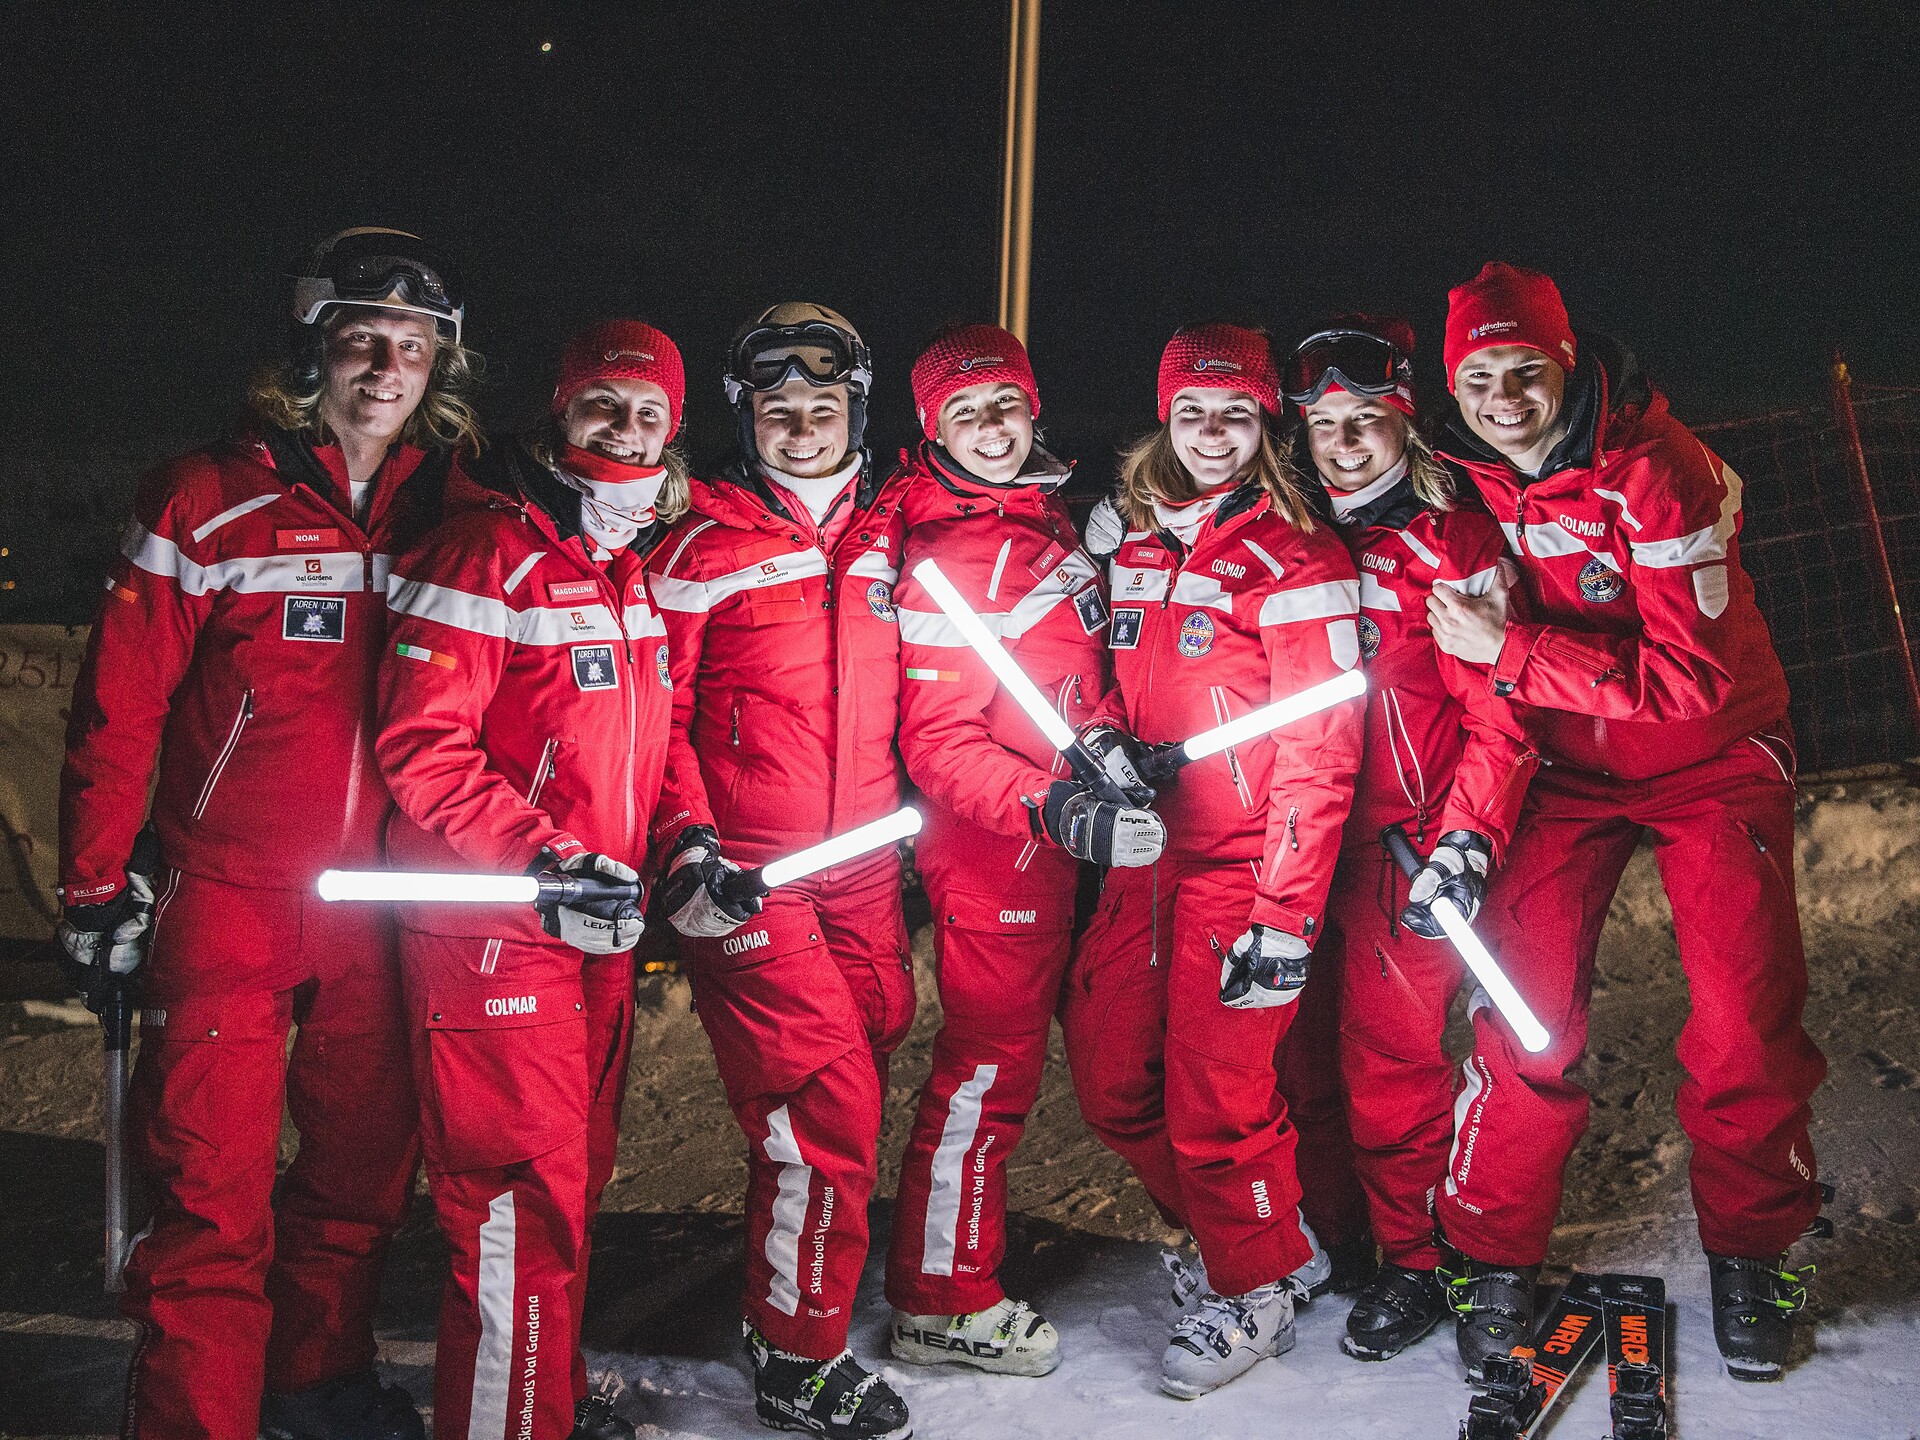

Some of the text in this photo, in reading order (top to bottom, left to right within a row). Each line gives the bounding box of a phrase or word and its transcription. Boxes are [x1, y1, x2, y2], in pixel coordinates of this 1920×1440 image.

[1479, 320, 1518, 332] skischools
[619, 350, 655, 361] skischools
[1208, 359, 1242, 371] skischools
[1559, 514, 1606, 537] COLMAR
[295, 534, 320, 542] NOAH
[1039, 553, 1055, 569] LAURA
[1137, 551, 1155, 559] GLORIA
[1362, 553, 1397, 574] COLMAR
[1211, 559, 1247, 579] COLMAR
[553, 585, 594, 596] MAGDALENA
[1119, 816, 1152, 825] LEVEL
[583, 919, 623, 930] LEVEL
[999, 909, 1037, 924] COLMAR
[722, 929, 771, 956] COLMAR
[485, 995, 538, 1017] COLMAR
[1458, 1125, 1480, 1185] Skischools
[1474, 1104, 1484, 1124] Val
[973, 1176, 985, 1195] Val
[1251, 1179, 1272, 1219] COLMAR
[967, 1196, 983, 1250] Skischools
[809, 1234, 825, 1295] Skischools
[819, 1186, 834, 1228] Gardena
[526, 1295, 540, 1353] Gardena
[897, 1324, 1004, 1359] HEAD
[1543, 1314, 1593, 1355] WRC
[524, 1356, 537, 1379] Val
